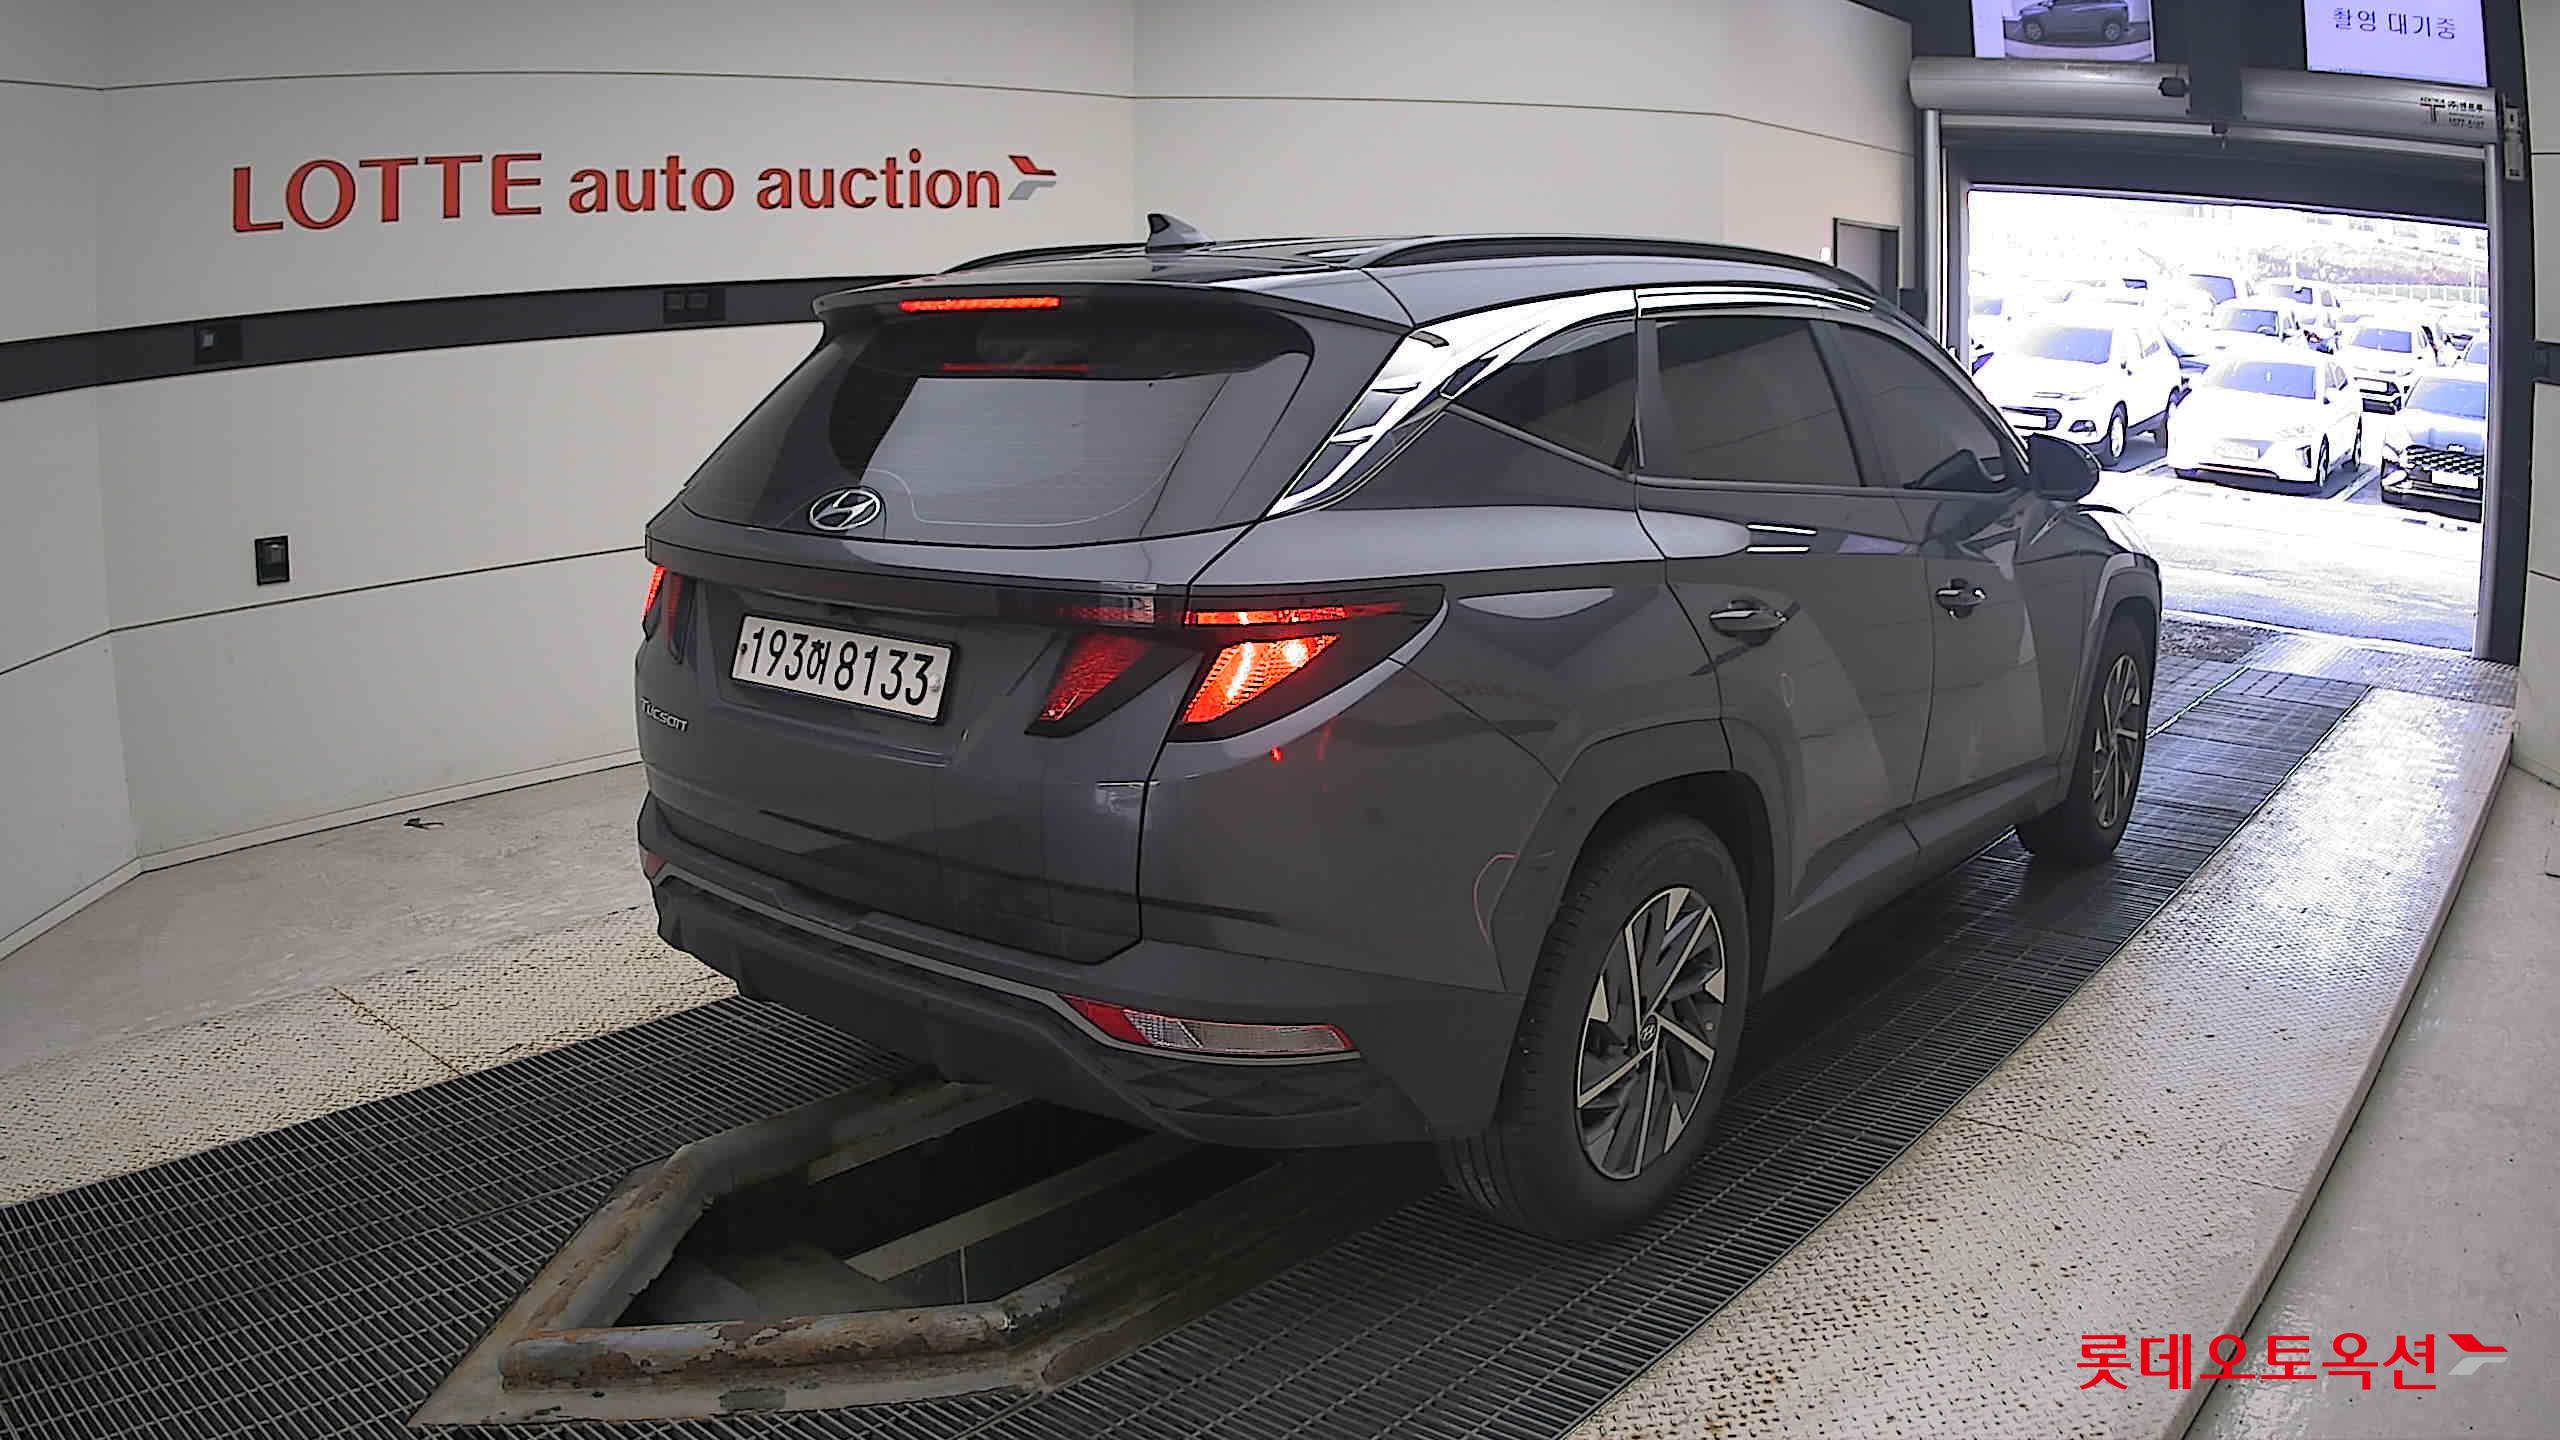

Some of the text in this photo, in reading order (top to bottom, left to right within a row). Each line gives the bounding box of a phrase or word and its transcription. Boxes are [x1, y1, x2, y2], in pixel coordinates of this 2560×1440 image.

[2333, 7, 2457, 41] 촬영 대기중
[233, 147, 1001, 233] LOTTE auto auction
[640, 696, 688, 732] TUCSON
